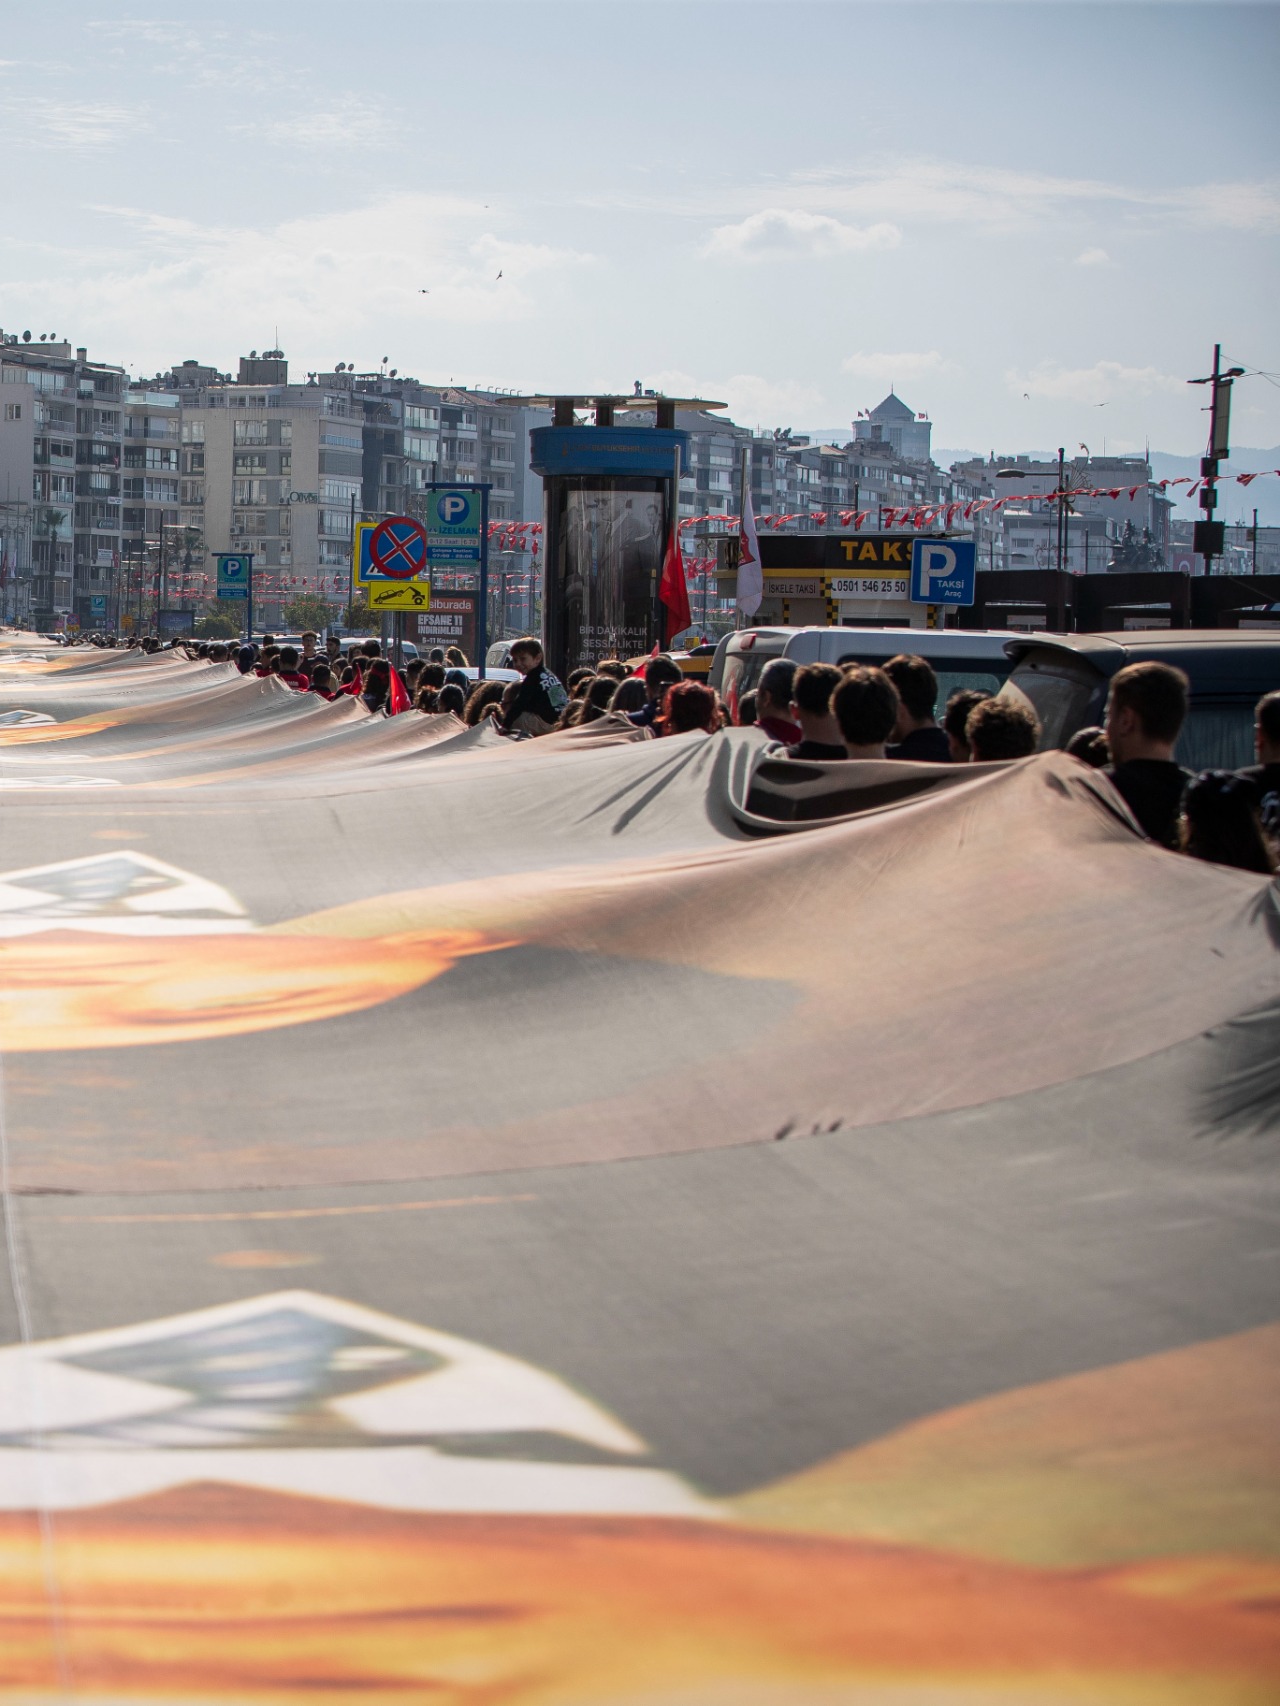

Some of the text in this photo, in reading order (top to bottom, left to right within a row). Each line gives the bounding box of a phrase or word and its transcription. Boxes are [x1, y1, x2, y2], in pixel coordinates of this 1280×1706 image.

[444, 496, 465, 522] P
[438, 526, 478, 535] İZELMAN
[227, 560, 240, 575] P
[920, 544, 957, 597] P
[768, 580, 816, 594] İSKELE TAKSİ
[837, 579, 906, 593] 0501 546 25 50
[937, 579, 965, 589] TAKSİ
[944, 589, 962, 599] Araç
[429, 600, 471, 610] siburada
[417, 614, 463, 626] EFSANE 11
[417, 626, 463, 635] İNDİRİMLERİ
[579, 625, 648, 636] BİR DAKİKALIK
[582, 638, 644, 649] SESSİZLİKTE
[579, 650, 595, 661] BİR
